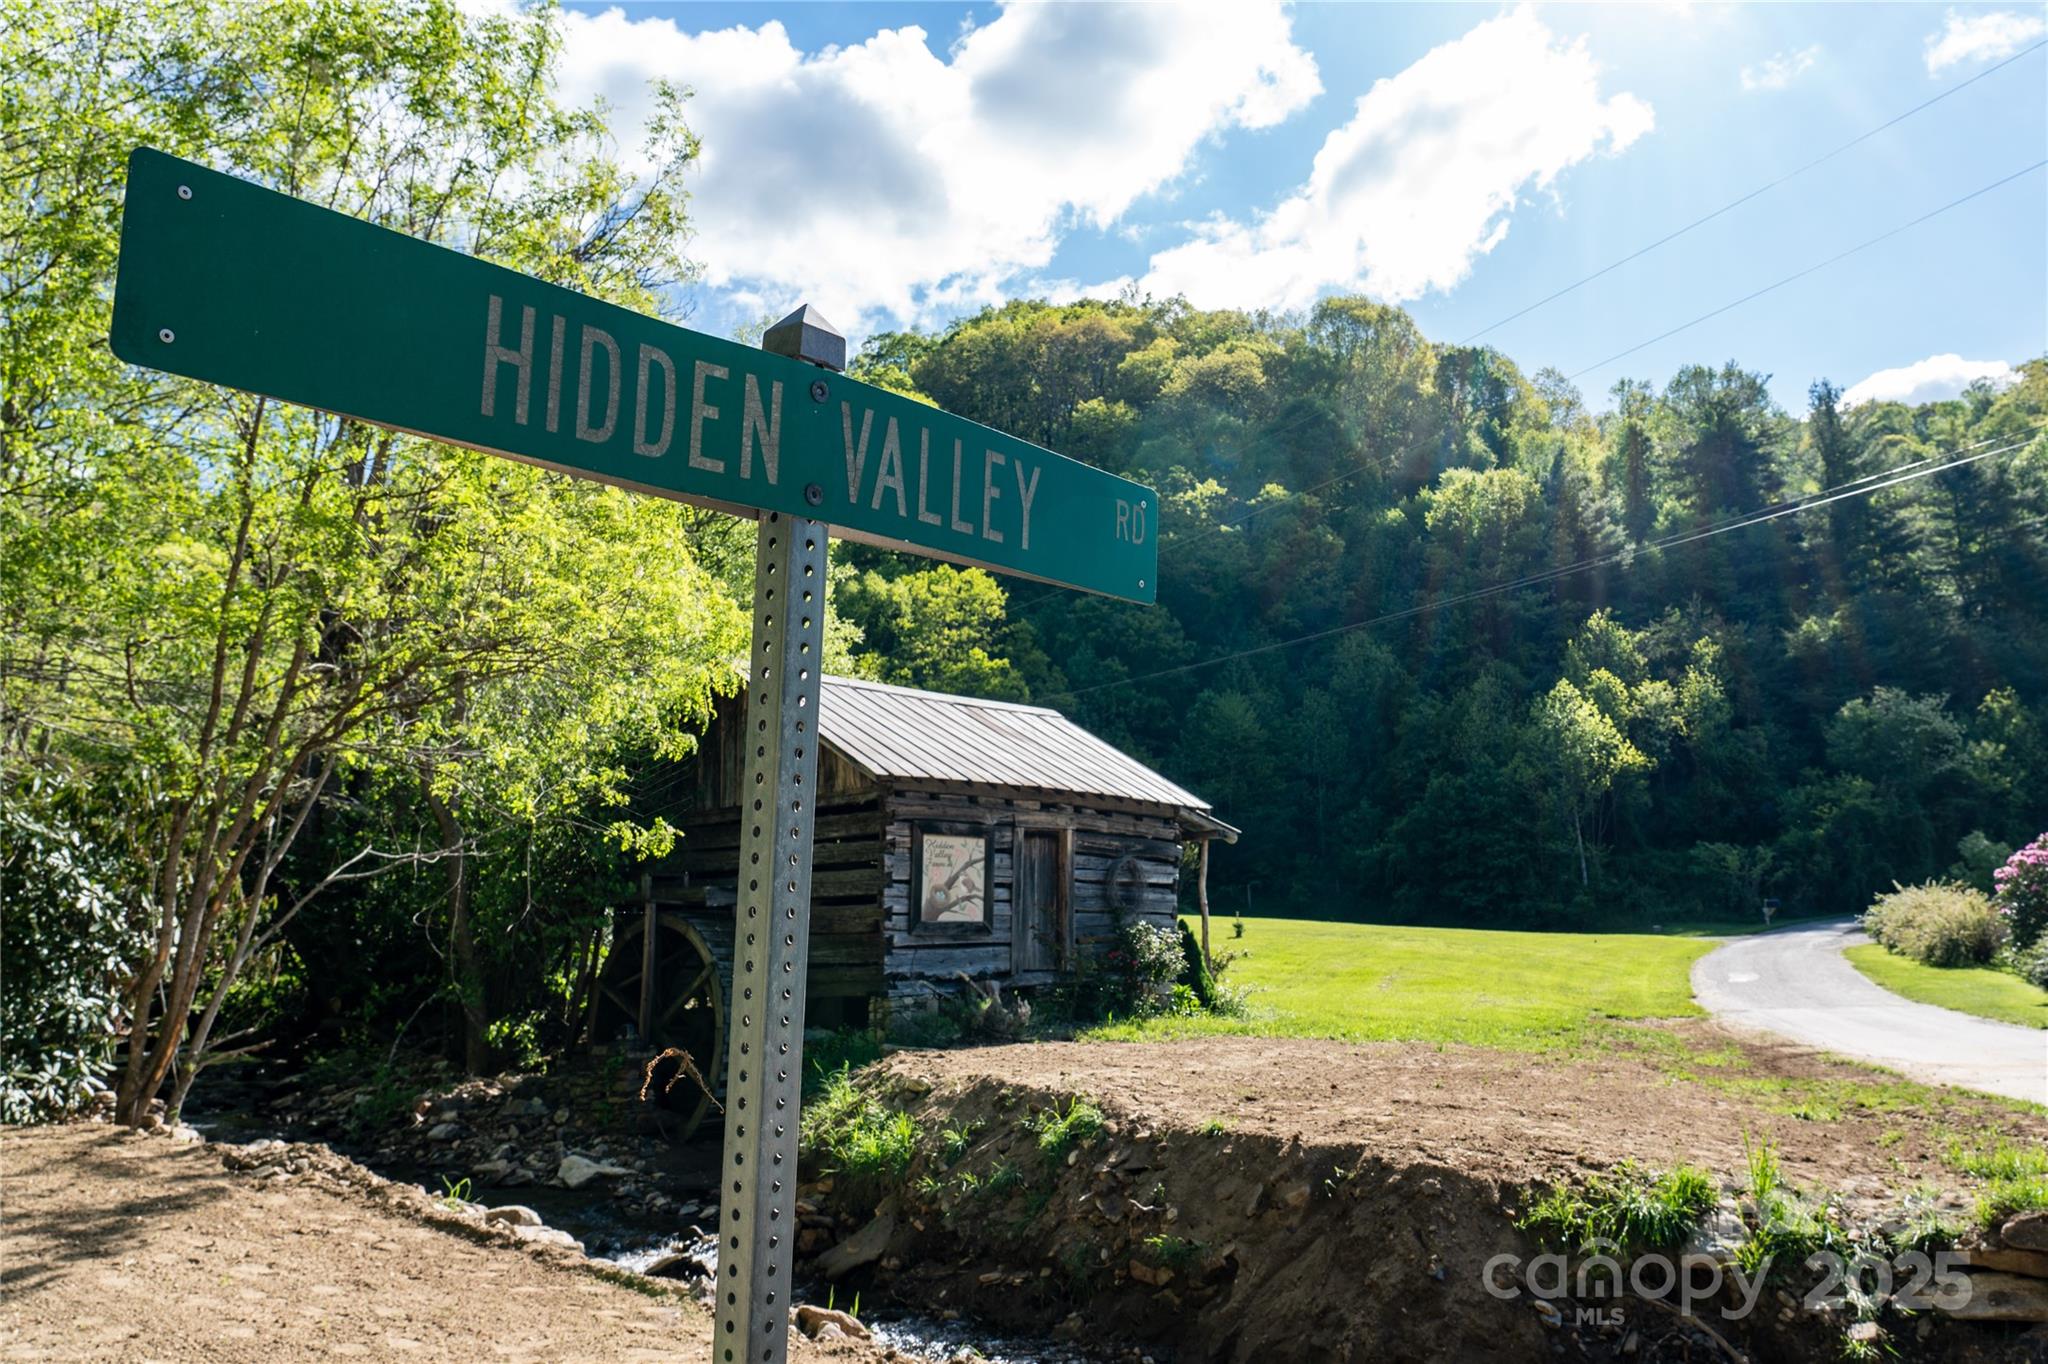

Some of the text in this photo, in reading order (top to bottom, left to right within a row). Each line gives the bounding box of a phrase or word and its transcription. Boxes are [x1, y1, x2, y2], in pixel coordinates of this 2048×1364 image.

[481, 295, 1146, 550] HIDDEN VALLEY RD
